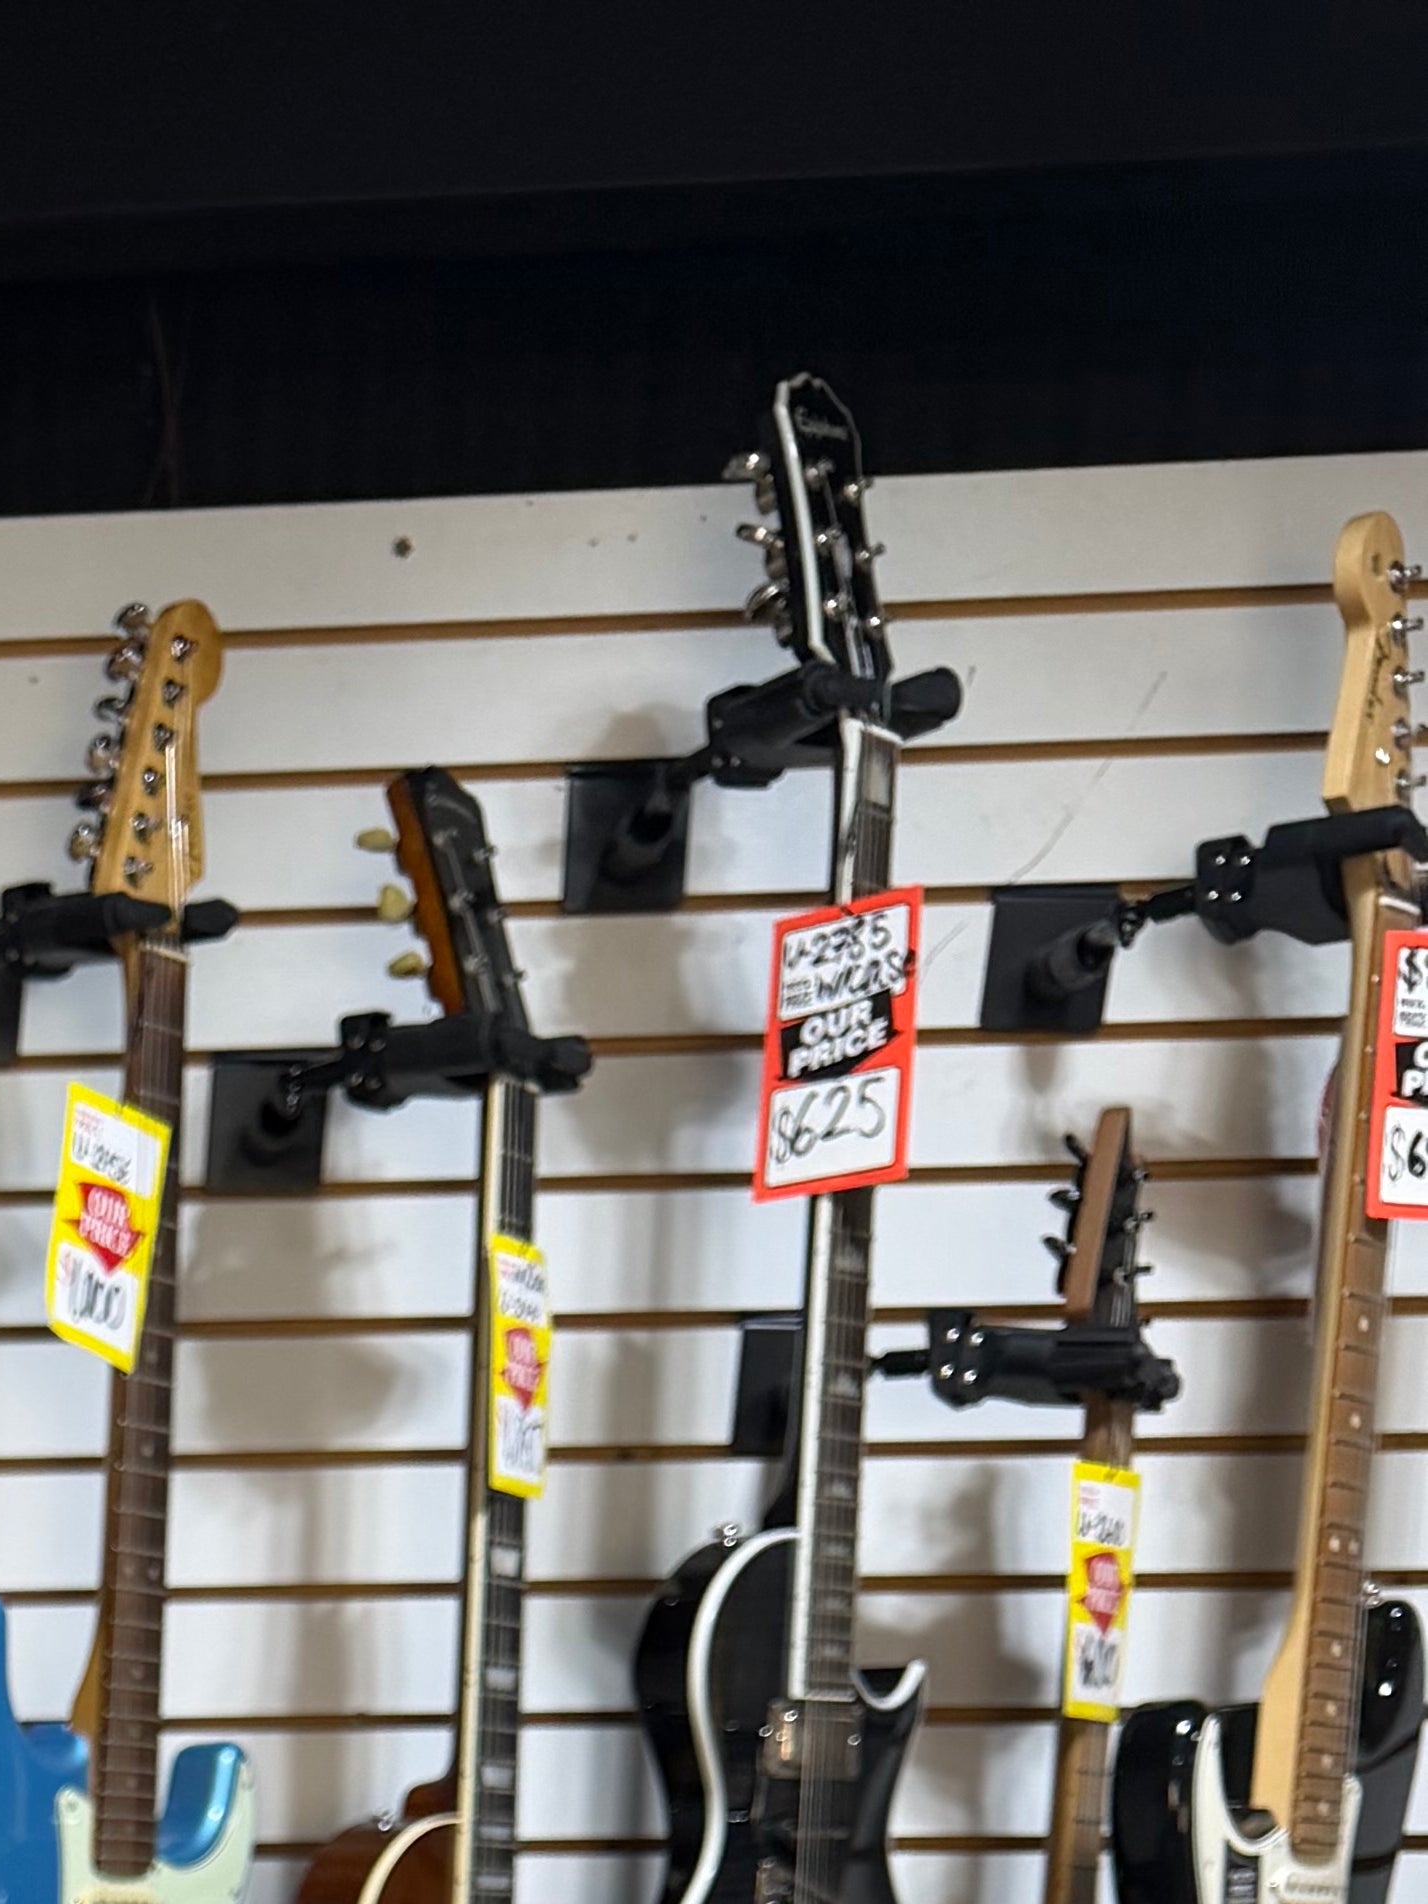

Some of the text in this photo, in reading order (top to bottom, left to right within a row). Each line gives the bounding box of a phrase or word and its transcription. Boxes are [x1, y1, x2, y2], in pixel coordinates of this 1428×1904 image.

[787, 1017, 889, 1081] PRICE
[800, 999, 874, 1047] OUR
[772, 1076, 886, 1165] $625
[1382, 1124, 1428, 1182] $6
